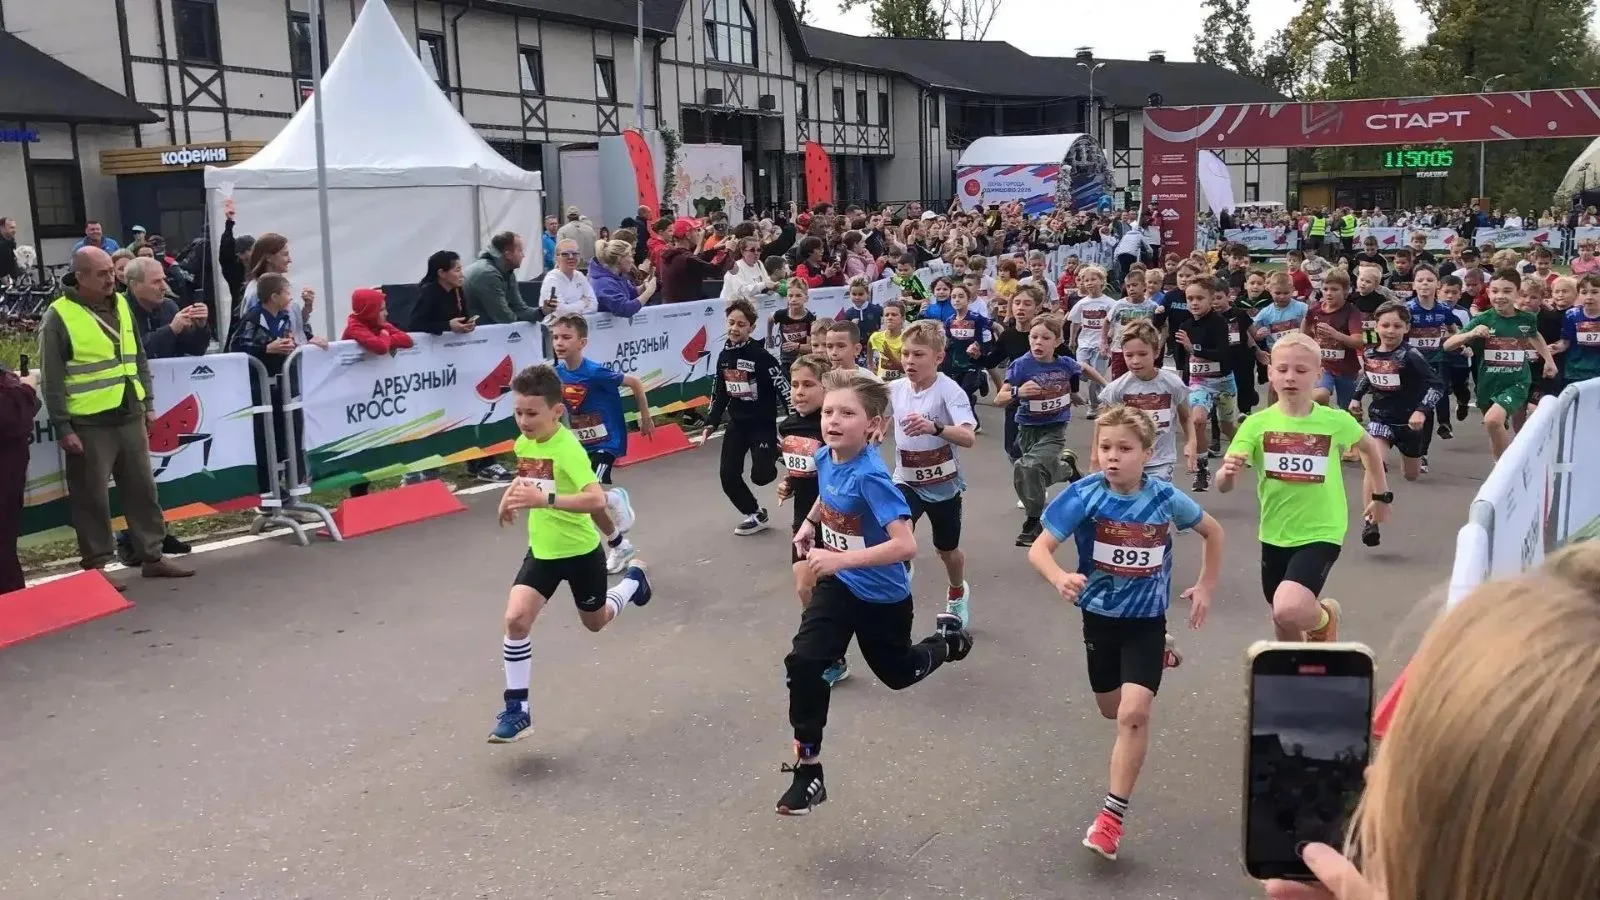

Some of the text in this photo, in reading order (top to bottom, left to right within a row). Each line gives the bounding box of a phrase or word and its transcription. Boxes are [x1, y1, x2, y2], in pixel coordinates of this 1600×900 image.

[1365, 110, 1470, 130] СТАРТ
[161, 146, 227, 167] кофейня
[954, 329, 968, 337] 842
[616, 332, 669, 358] АРБУЗНЫЙ
[1418, 339, 1436, 347] 817
[1495, 351, 1515, 360] 821
[1192, 364, 1210, 373] 873
[372, 363, 457, 399] АРБУЗНЫЙ
[1372, 374, 1388, 385] 815
[346, 395, 407, 424] КРОСС
[1041, 399, 1062, 411] 825
[578, 428, 597, 440] 820
[788, 456, 807, 469] 883
[1278, 456, 1314, 472] 850
[915, 466, 944, 481] 834
[825, 529, 849, 551] 813
[1112, 548, 1151, 567] 893
